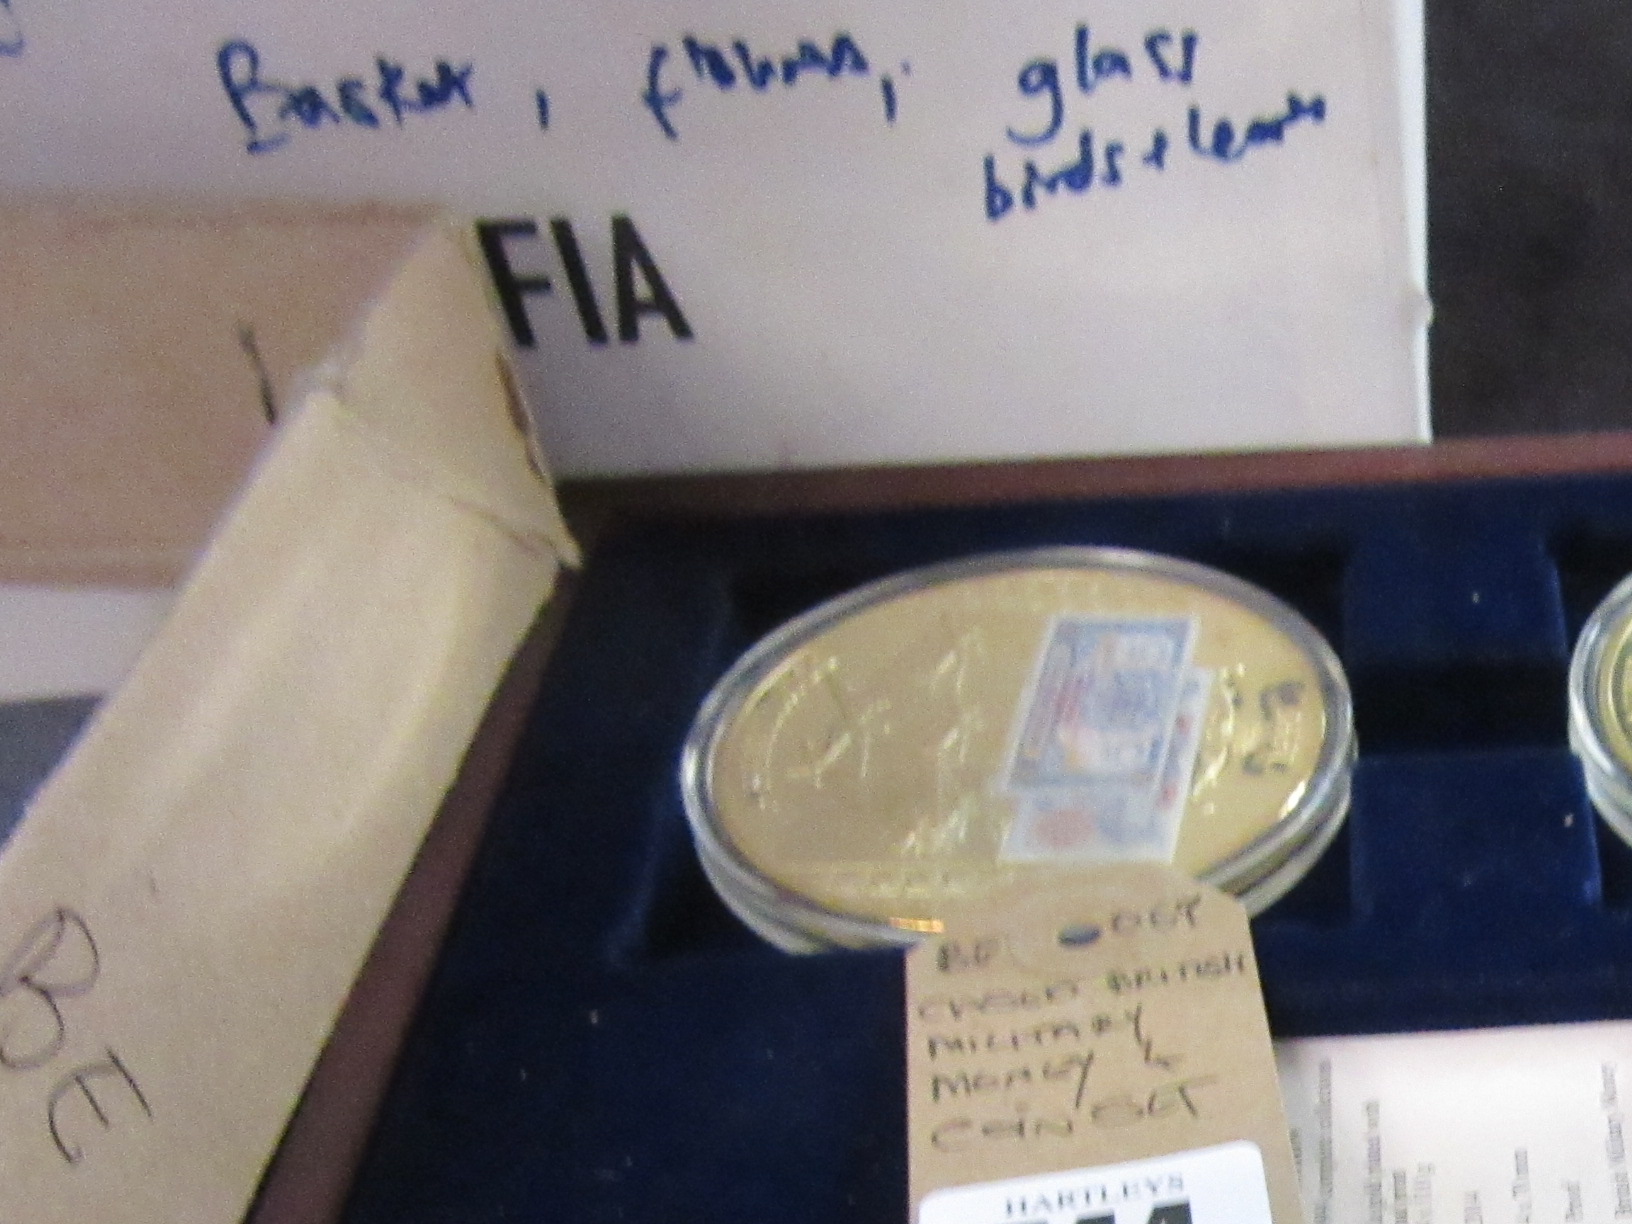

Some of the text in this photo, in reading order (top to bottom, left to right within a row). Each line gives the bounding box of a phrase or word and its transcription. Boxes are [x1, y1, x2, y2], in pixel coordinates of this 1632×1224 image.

[1006, 25, 1198, 144] glass
[475, 212, 694, 348] FIA
[1006, 1172, 1185, 1219] HARTLEYS
